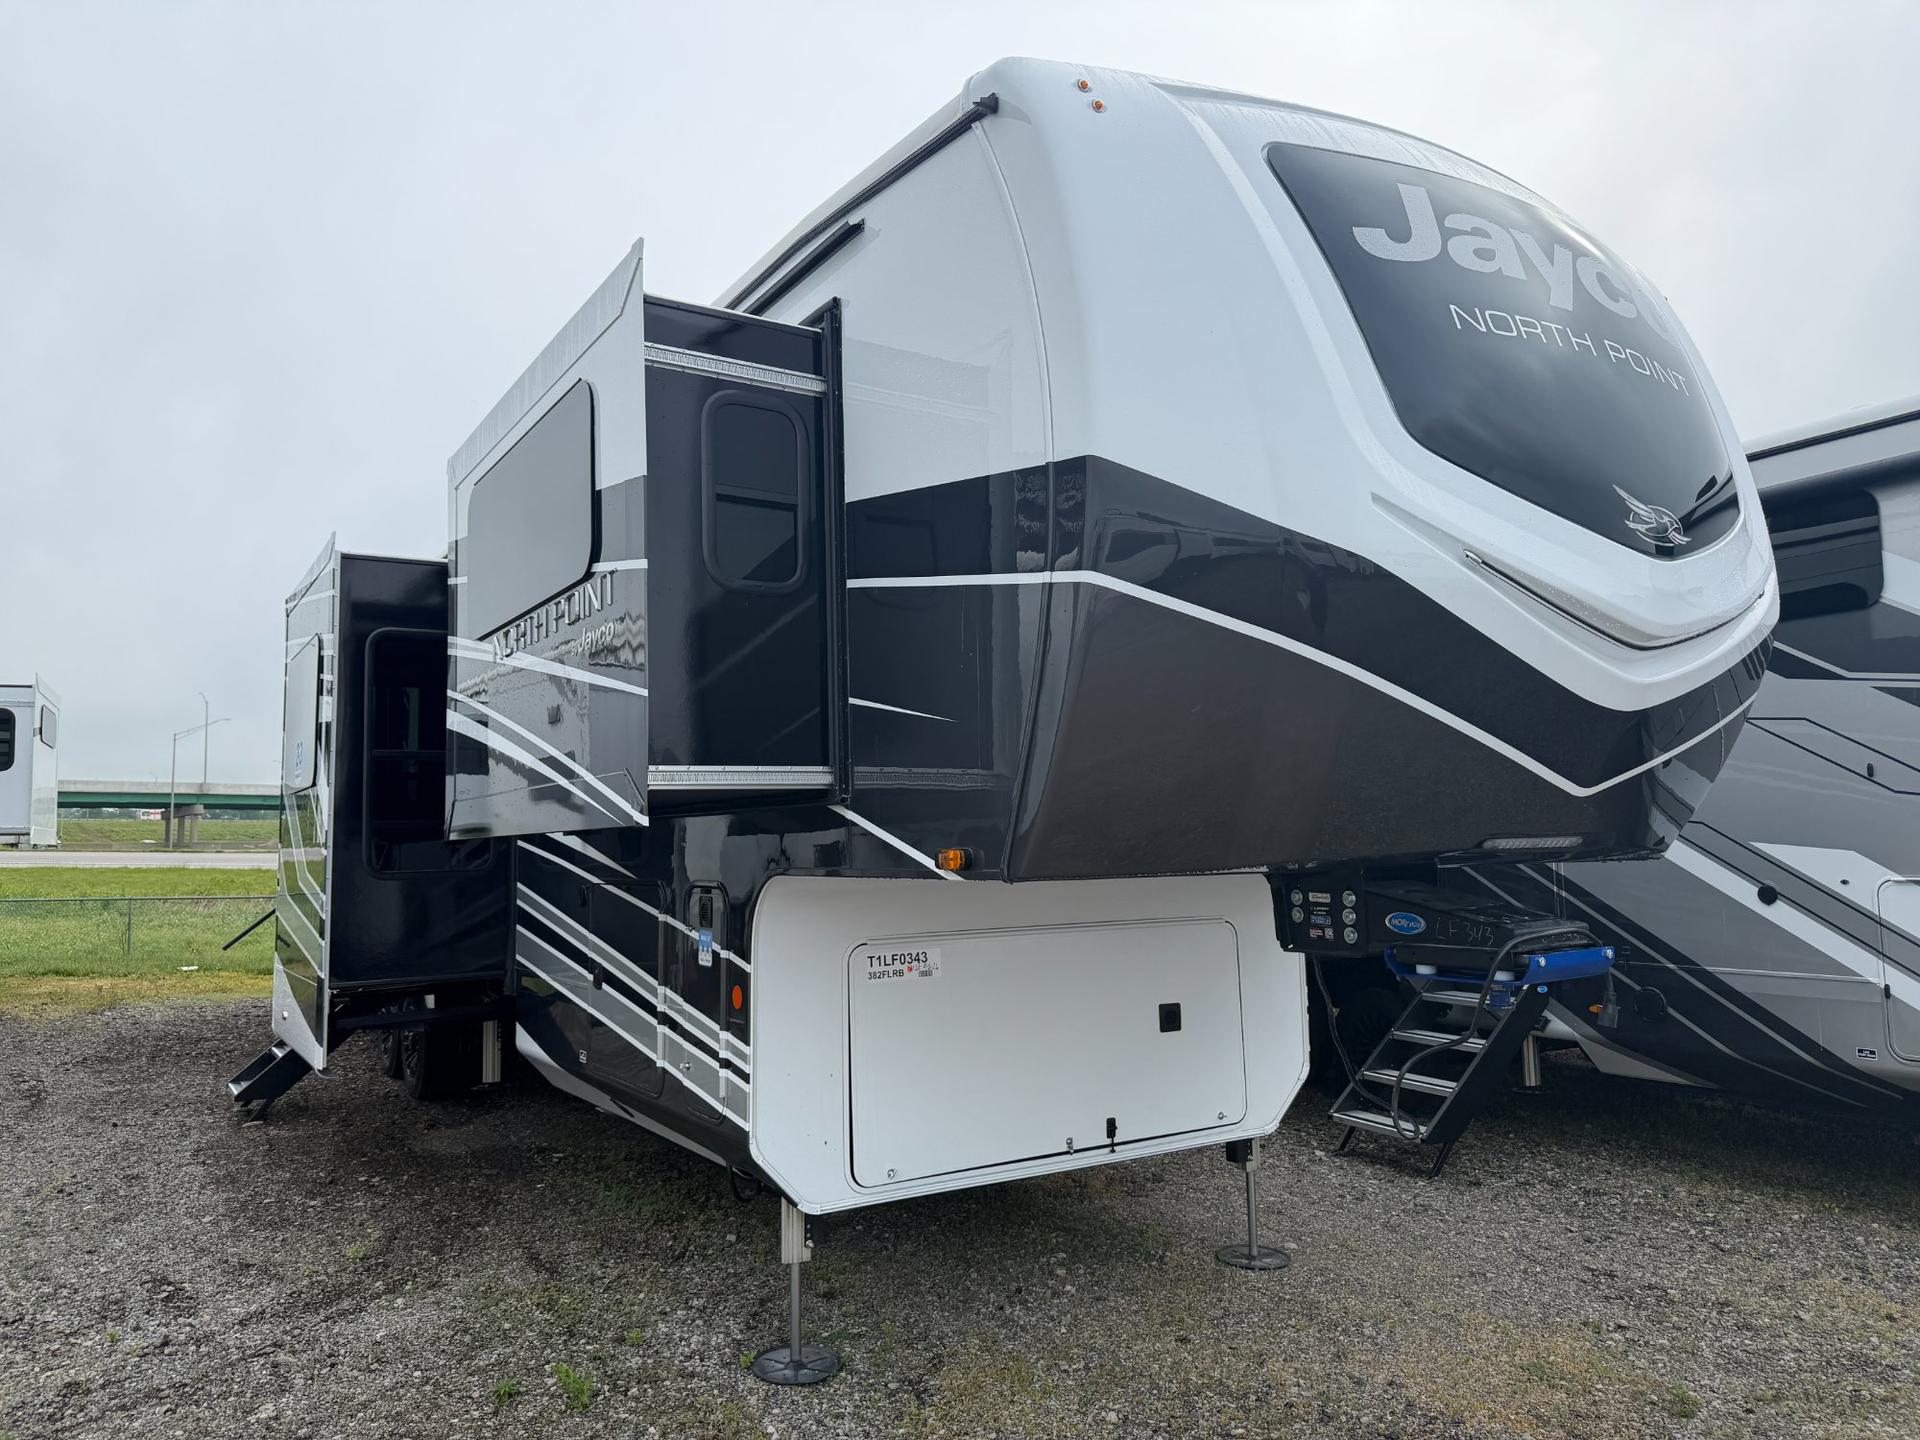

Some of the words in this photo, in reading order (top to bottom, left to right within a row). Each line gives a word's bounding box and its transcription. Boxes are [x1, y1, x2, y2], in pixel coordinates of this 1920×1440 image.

[1449, 304, 1597, 357] NORTH
[1603, 339, 1690, 397] POINT
[551, 568, 618, 634] POINT
[577, 621, 614, 653] Jayco
[867, 951, 928, 968] T1LF0343
[867, 969, 905, 980] 382FLRB
